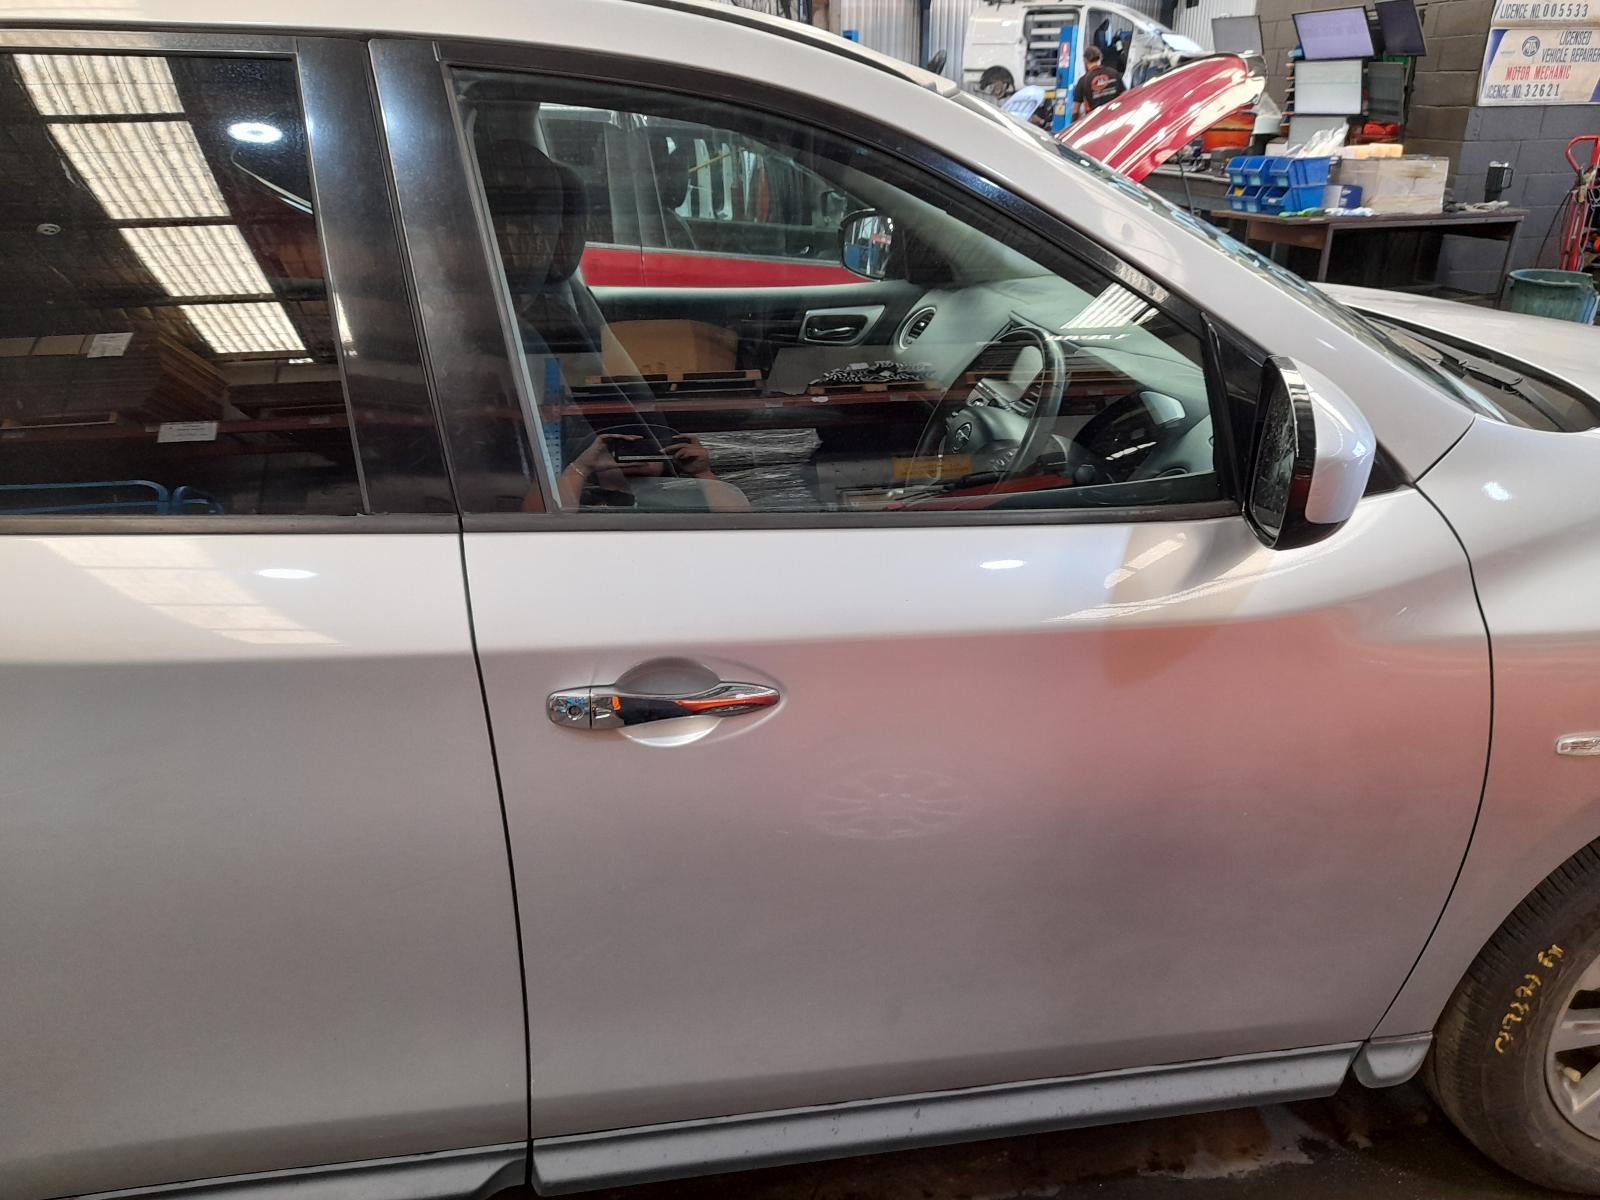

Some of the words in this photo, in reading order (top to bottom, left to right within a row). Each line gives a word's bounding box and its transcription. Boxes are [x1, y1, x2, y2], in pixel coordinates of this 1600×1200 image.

[1500, 4, 1528, 18] LICENCE
[1543, 4, 1589, 17] 005533
[1559, 31, 1592, 45] LICENSED
[1541, 48, 1568, 62] VEHICLE
[1505, 66, 1531, 80] MOTOR
[1534, 65, 1571, 80] MECHANIC
[1486, 84, 1510, 98] ICENCE
[1523, 84, 1560, 97] 32621
